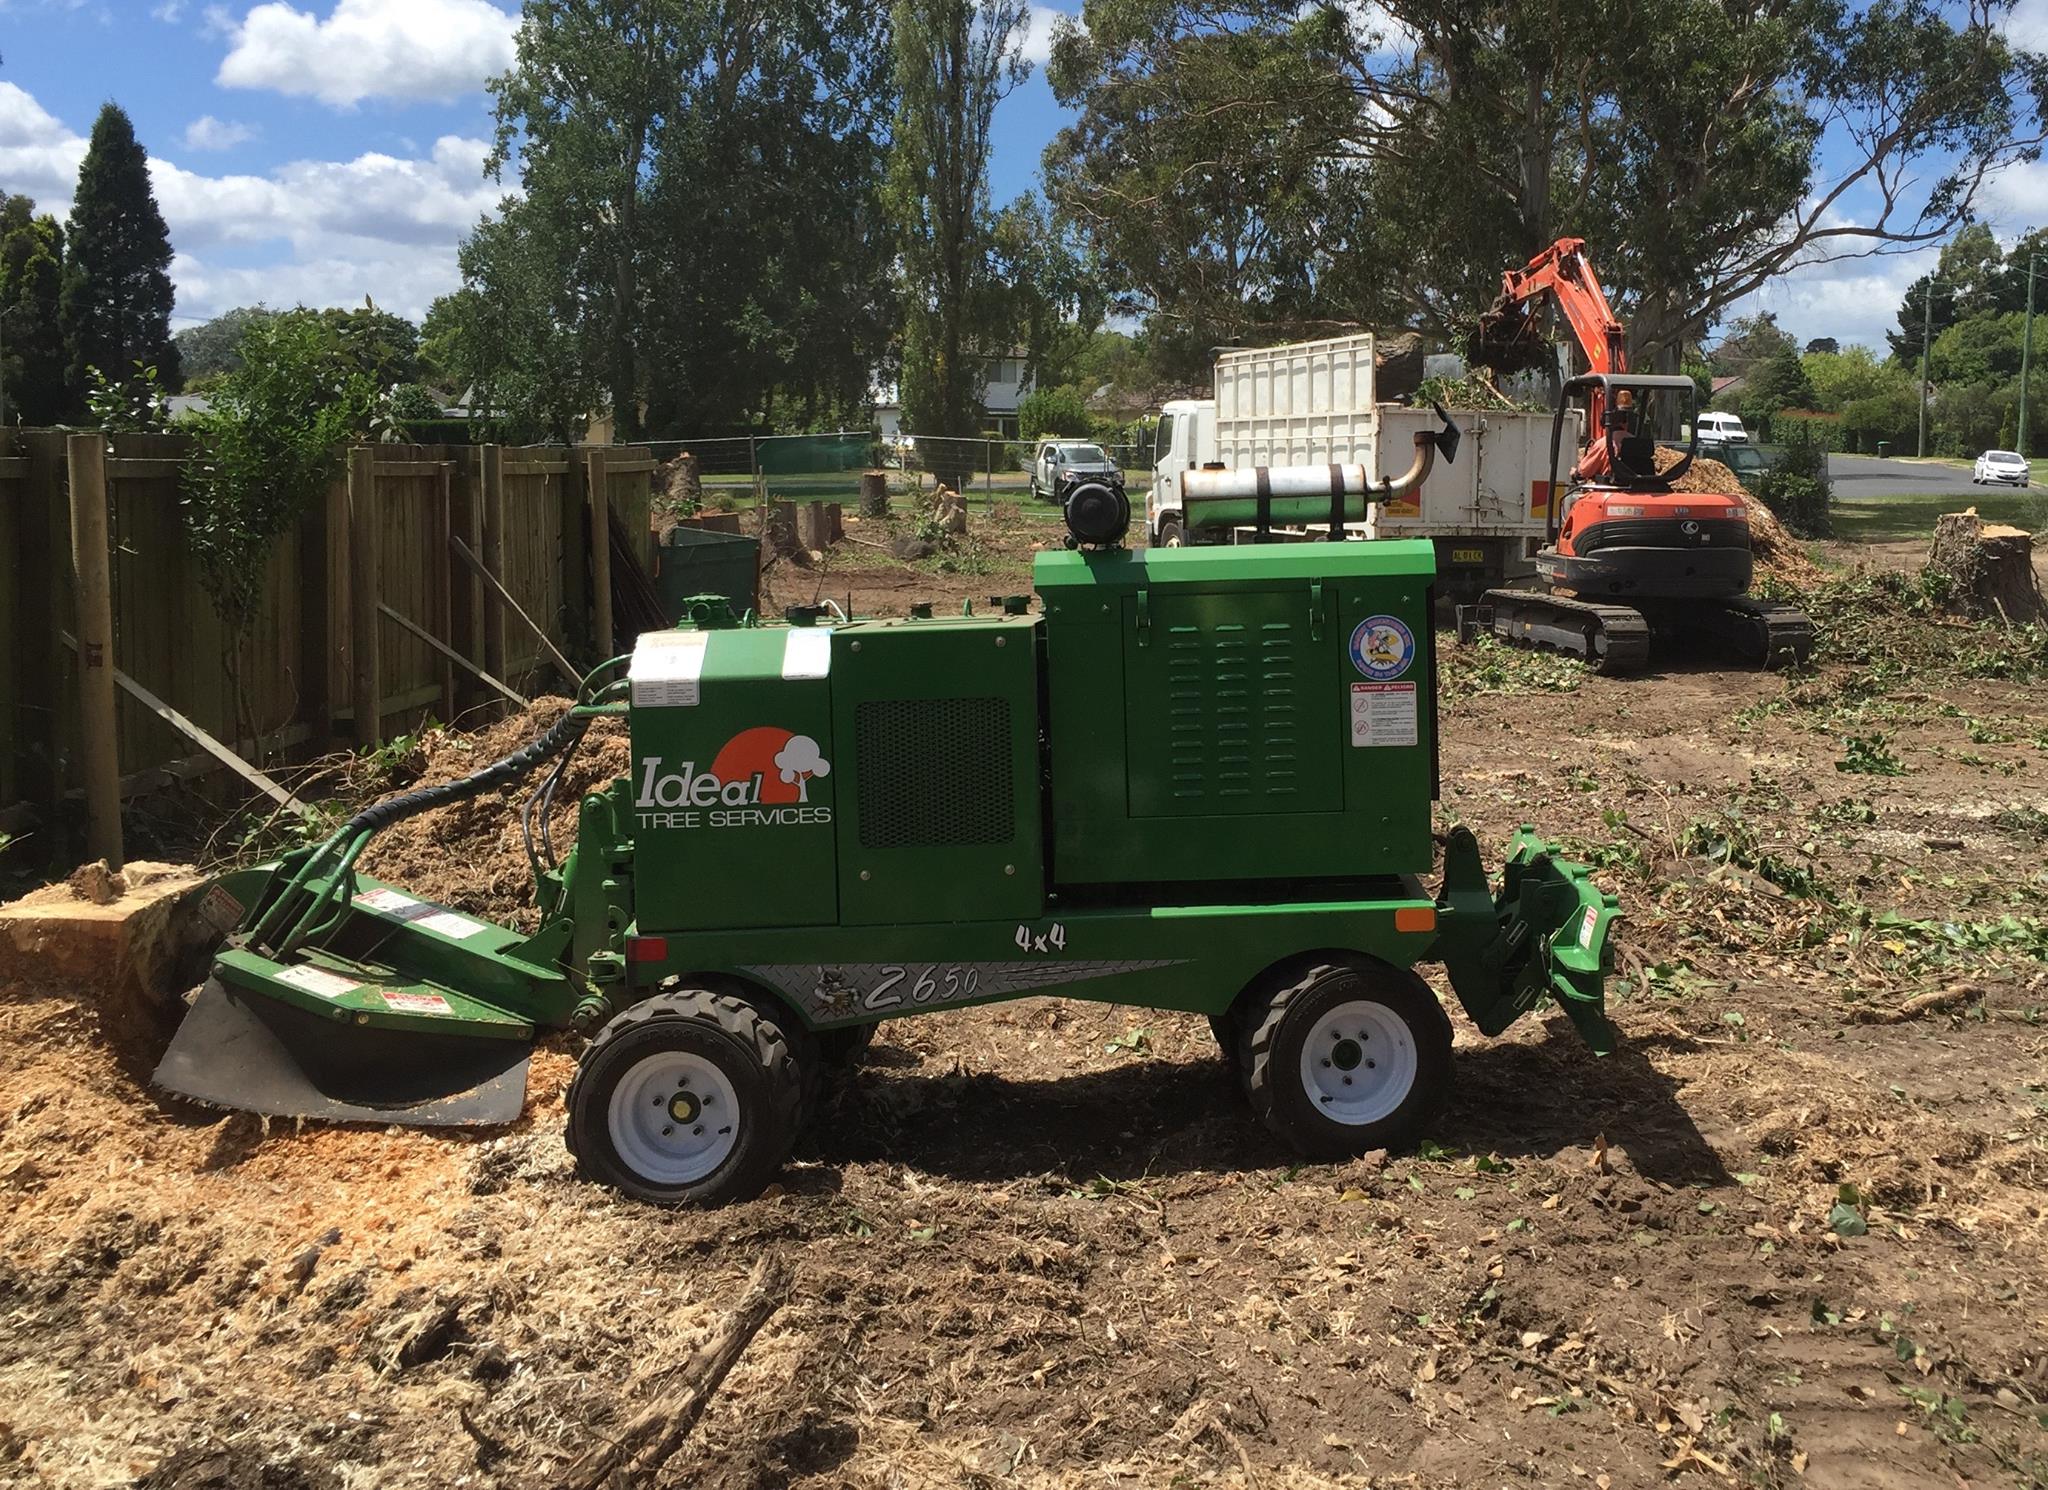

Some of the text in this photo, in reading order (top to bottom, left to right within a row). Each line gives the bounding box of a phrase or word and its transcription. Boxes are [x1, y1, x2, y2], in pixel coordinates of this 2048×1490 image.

[635, 757, 764, 808] Ideal
[635, 807, 832, 829] TREE SERVICES
[1015, 922, 1067, 953] 4x4
[864, 965, 979, 1010] 2650
